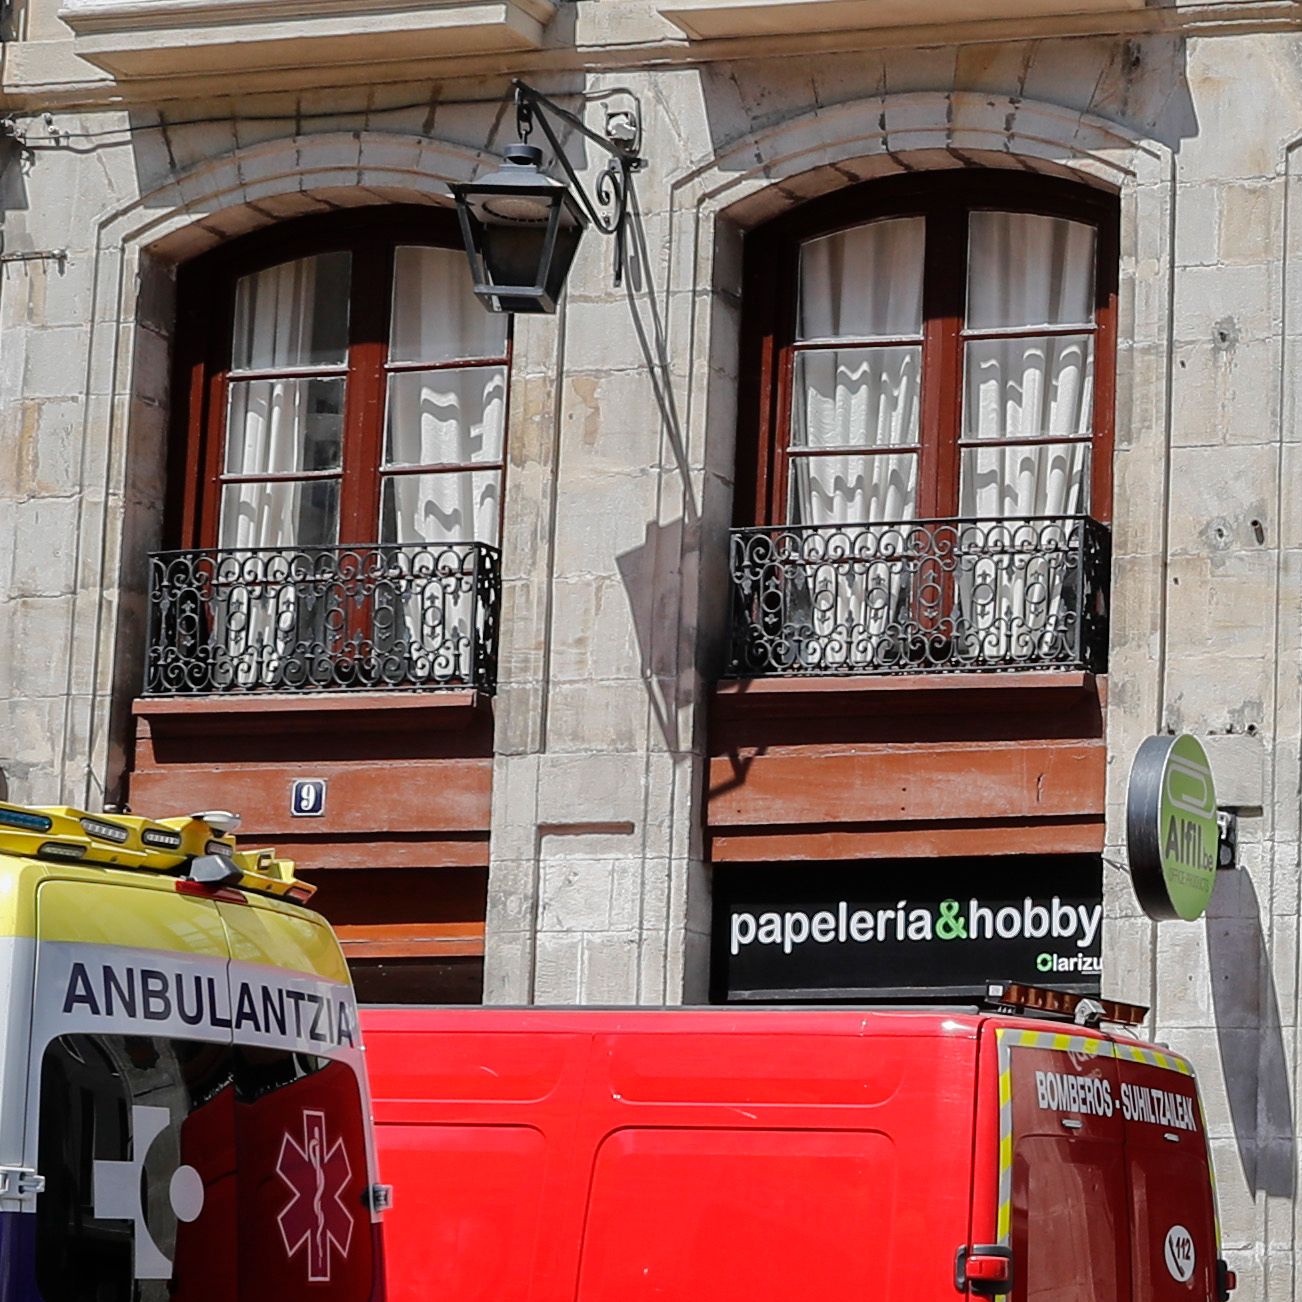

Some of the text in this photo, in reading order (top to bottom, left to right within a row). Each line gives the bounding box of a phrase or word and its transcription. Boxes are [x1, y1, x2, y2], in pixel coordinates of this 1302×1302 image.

[301, 783, 316, 811] 9
[731, 896, 1102, 955] papelería&hobby
[63, 961, 354, 1048] ANBULANTZIA
[1035, 1071, 1112, 1118] BOMBEROS
[1120, 1083, 1197, 1131] SUHILTZAILEAK
[1176, 1236, 1191, 1260] 112
